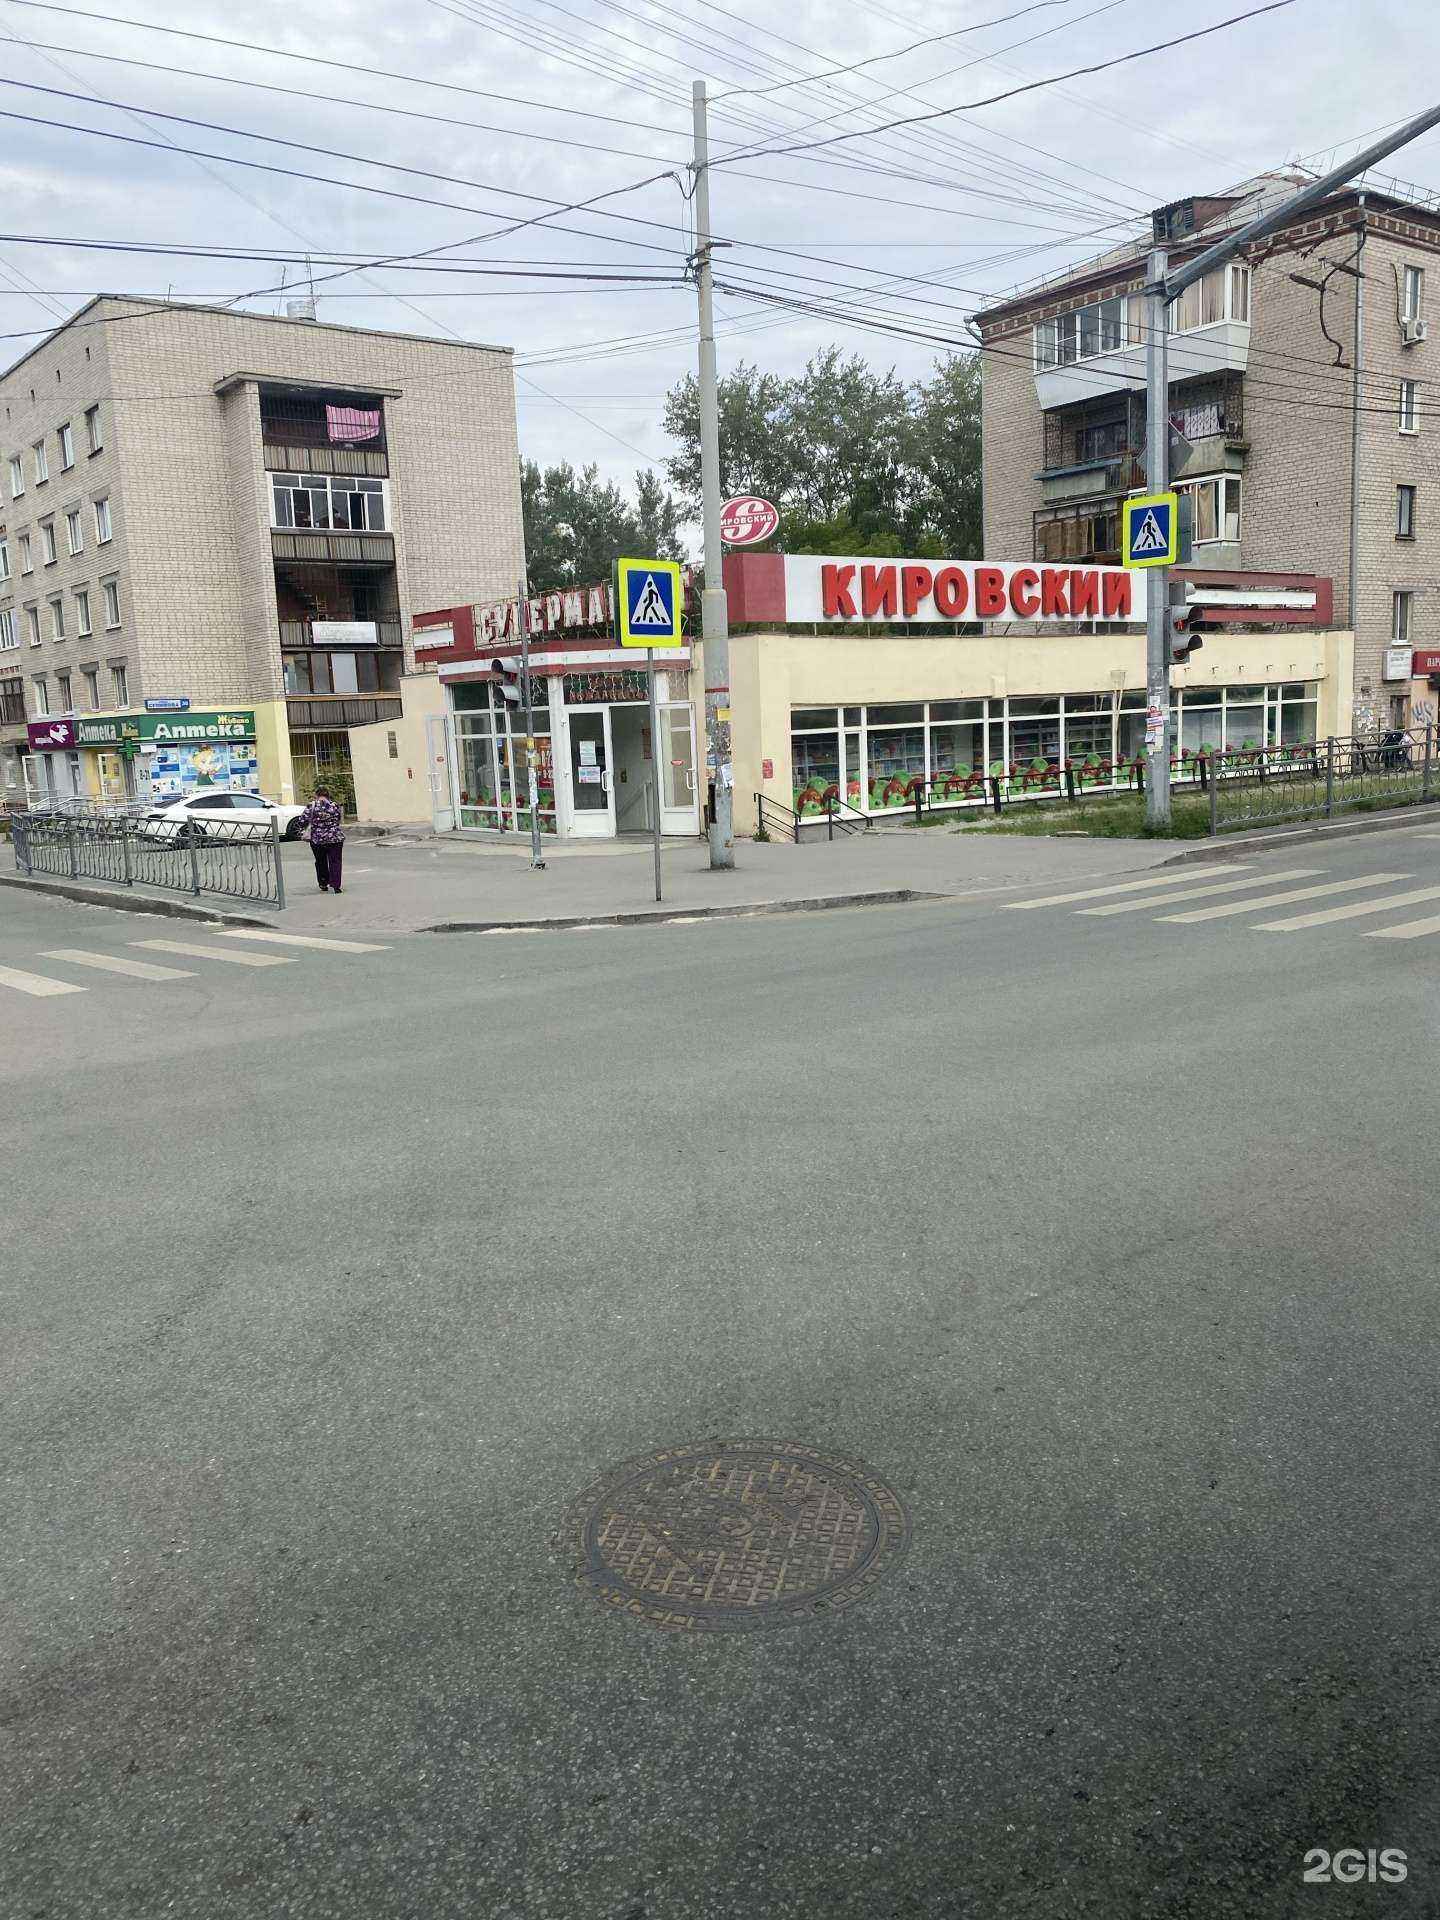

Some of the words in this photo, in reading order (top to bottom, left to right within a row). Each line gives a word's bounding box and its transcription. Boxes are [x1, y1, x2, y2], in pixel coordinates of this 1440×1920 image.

[720, 513, 774, 525] ИРОВСКИЙ
[821, 564, 1132, 617] КИРОВСКИЙ
[79, 721, 117, 742] Аптека
[154, 723, 246, 740] Аптека
